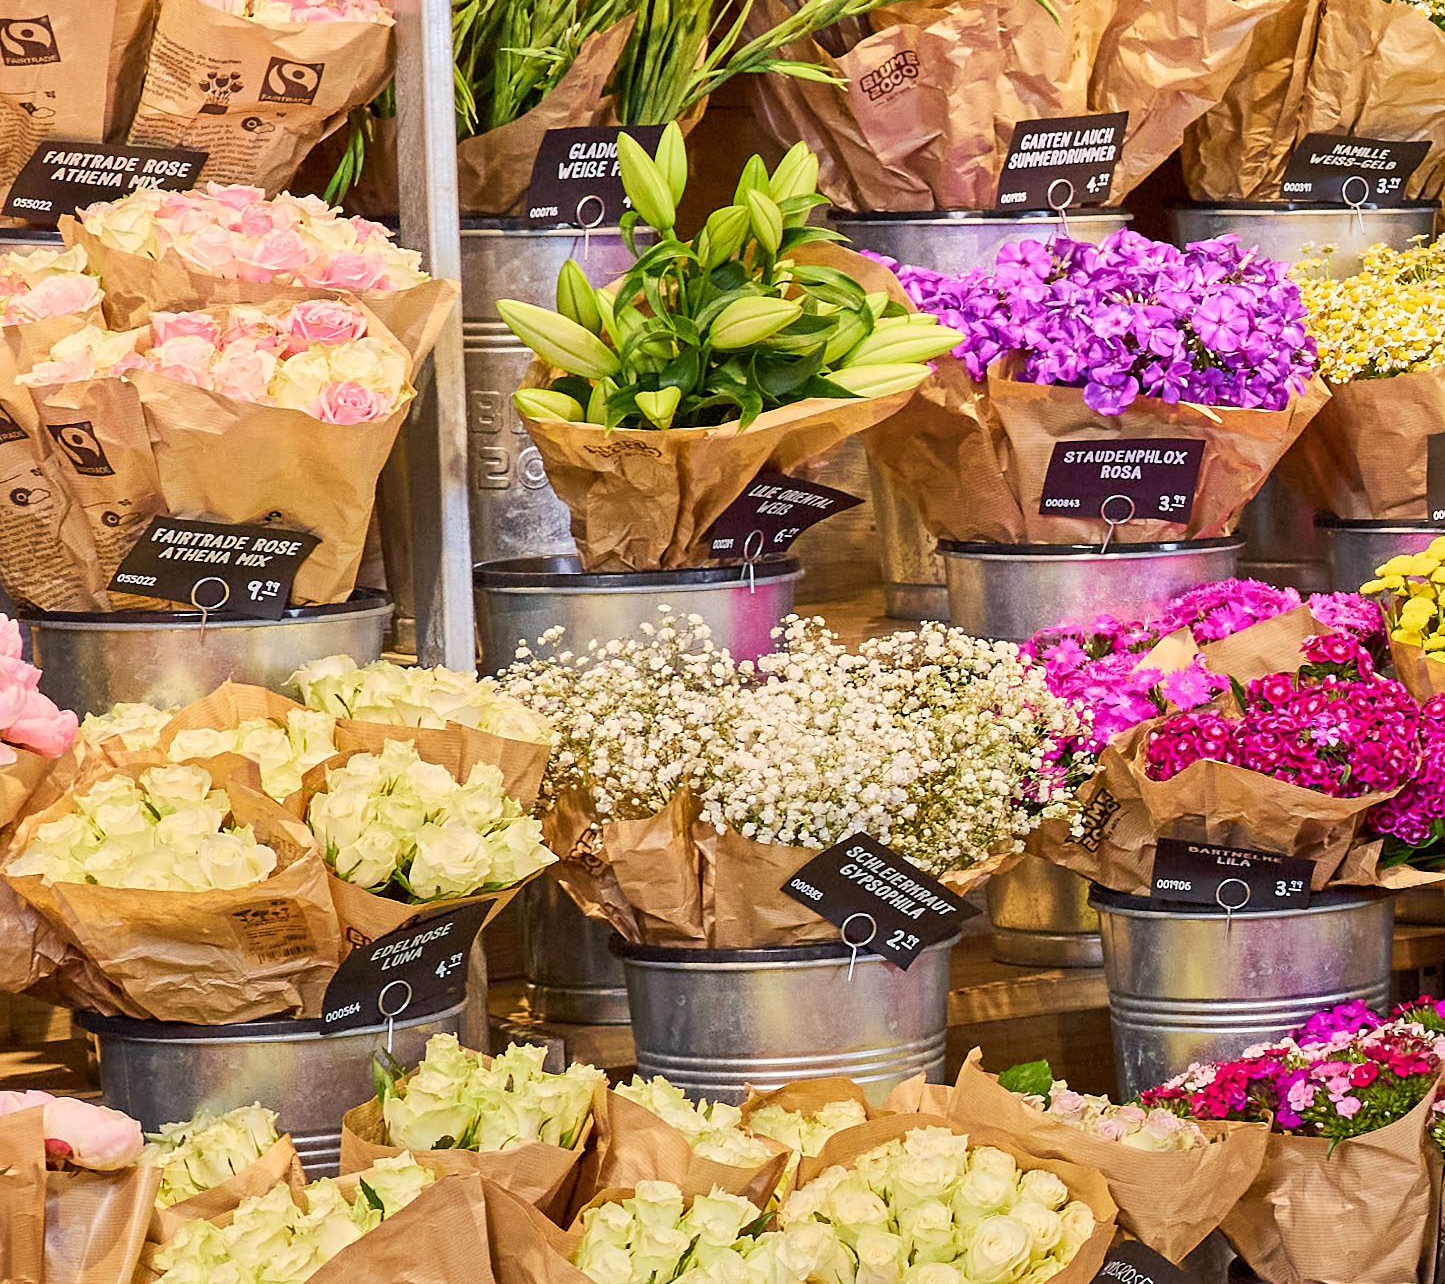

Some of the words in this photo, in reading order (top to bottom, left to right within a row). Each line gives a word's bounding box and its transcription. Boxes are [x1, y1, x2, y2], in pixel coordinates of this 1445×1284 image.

[859, 50, 921, 95] BLUME
[870, 65, 919, 102] 2000
[1021, 131, 1071, 151] GARTEN
[1073, 128, 1115, 148] LAUCH
[1008, 146, 1116, 170] SUMMERDRUMMER
[1309, 153, 1398, 171] WEISS-GELB
[1331, 143, 1391, 161] KAMILLE
[43, 150, 139, 172] FAIRTRADE
[142, 159, 192, 178] ROSE
[51, 168, 124, 188] ATHENA
[128, 174, 165, 191] MIX
[13, 198, 52, 212] 055022
[1063, 450, 1188, 465] STAUDENPHLOX
[1100, 465, 1142, 480] ROSA
[776, 488, 835, 510] ORIENTAL
[1045, 498, 1080, 509] 000843
[1158, 495, 1187, 512] 3.99
[152, 528, 249, 550] FAIRTRADE
[253, 537, 302, 556] ROSE
[159, 547, 232, 565] ATHENA
[235, 553, 272, 568] MIX
[117, 573, 157, 588] 055022
[247, 580, 280, 602] 9.99
[1216, 857, 1251, 868] LILA
[839, 862, 926, 920] GYPSOPHILA
[846, 846, 957, 915] SCHLEIERKRAUT
[1156, 879, 1192, 892] 001906
[1274, 880, 1304, 897] 3.99
[370, 923, 454, 961] EDELROSE
[886, 929, 920, 951] 2.99
[381, 946, 423, 971] LUNA
[435, 952, 464, 978] 4.99
[325, 1001, 361, 1023] 000564
